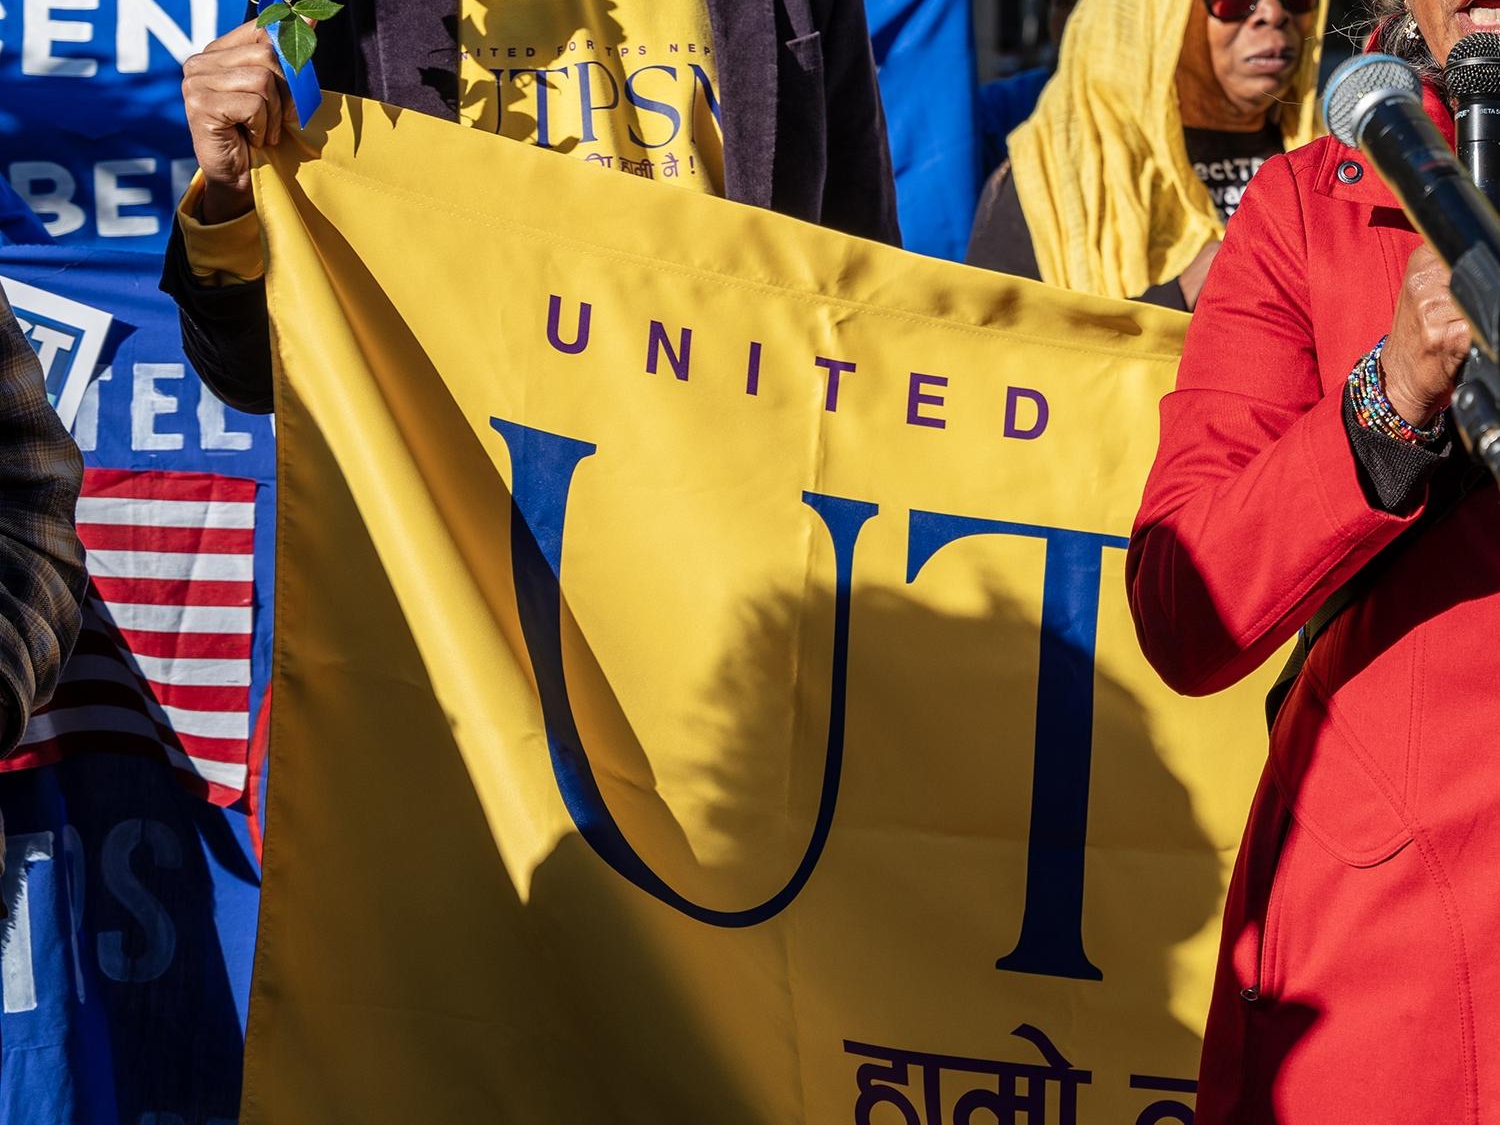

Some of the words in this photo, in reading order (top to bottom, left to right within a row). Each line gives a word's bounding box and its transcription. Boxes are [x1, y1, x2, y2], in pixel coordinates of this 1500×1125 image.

[557, 40, 595, 56] FOR
[605, 45, 647, 58] TPS
[669, 43, 711, 56] NEP
[546, 295, 1050, 441] UNITED
